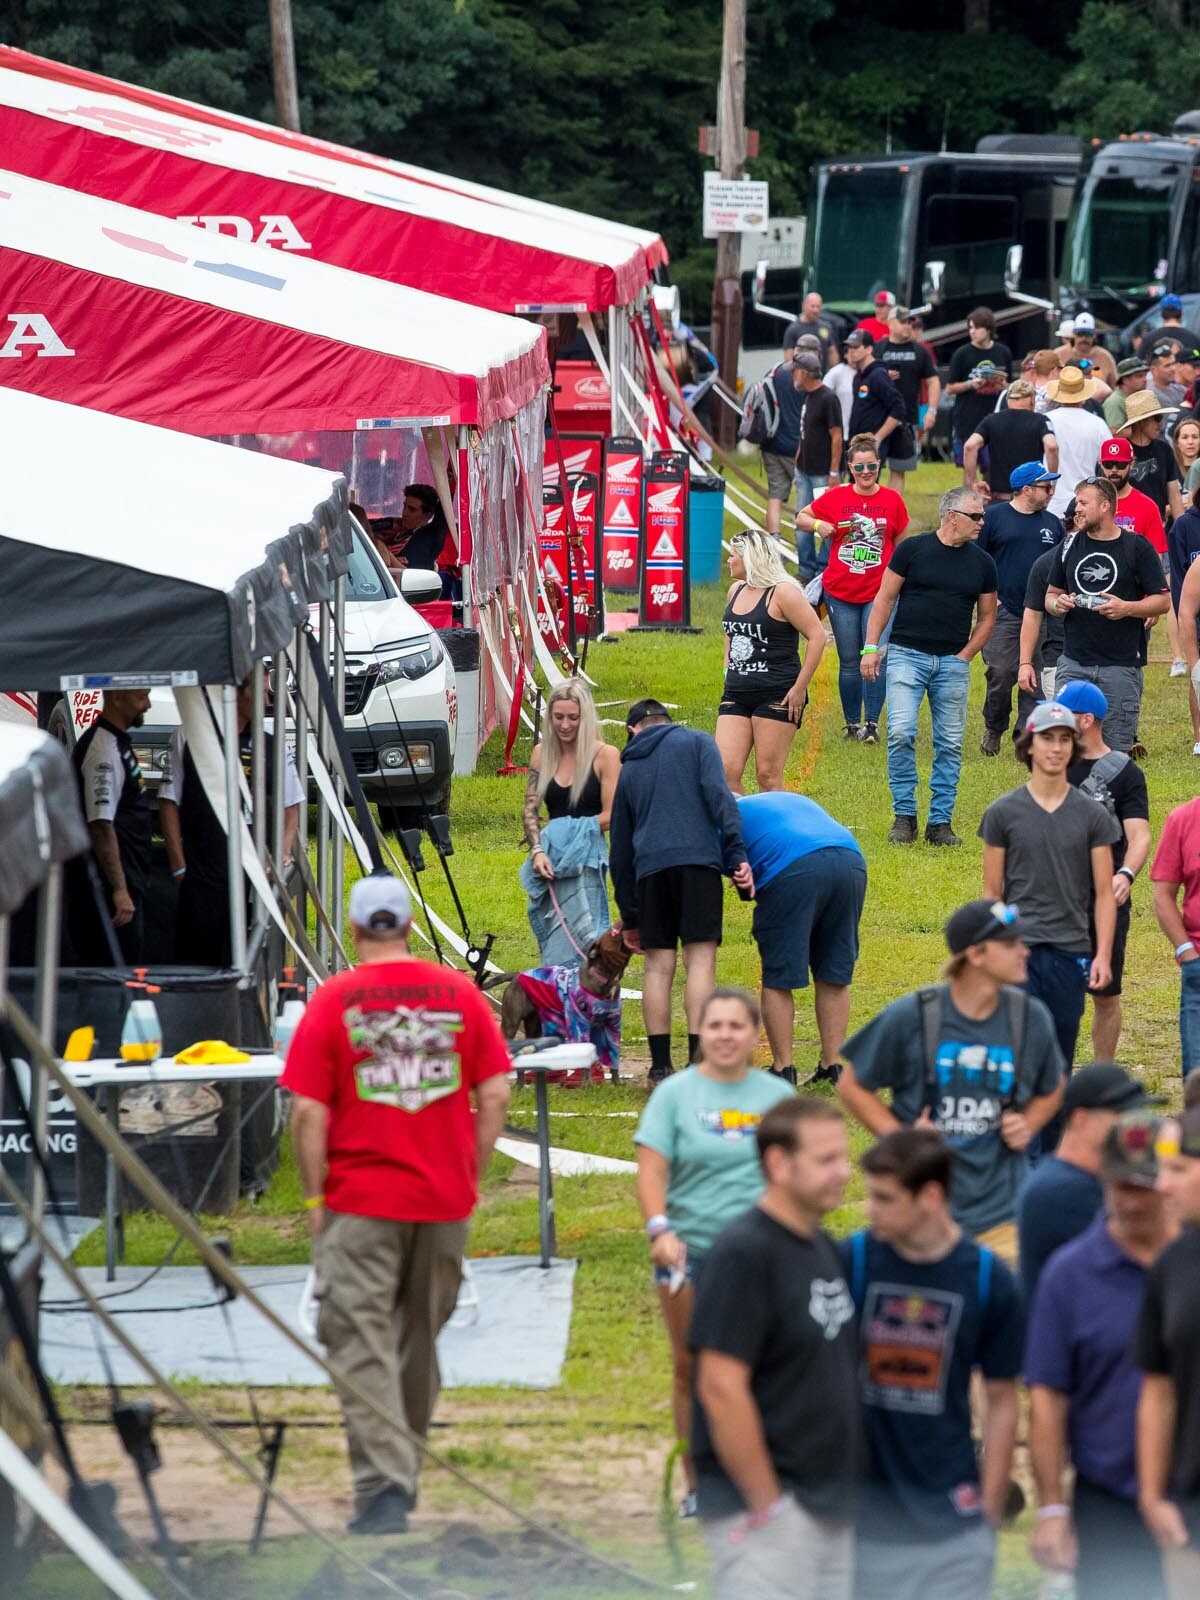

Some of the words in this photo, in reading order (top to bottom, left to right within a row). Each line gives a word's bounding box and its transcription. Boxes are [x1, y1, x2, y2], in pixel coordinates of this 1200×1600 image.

[607, 476, 640, 484] HONDA
[841, 505, 888, 515] SECURITY
[606, 549, 630, 560] RIDE
[608, 558, 634, 571] RED
[650, 583, 675, 595] RIDE
[652, 592, 679, 606] RED
[722, 620, 769, 644] EKYLL
[73, 691, 101, 707] RIDE
